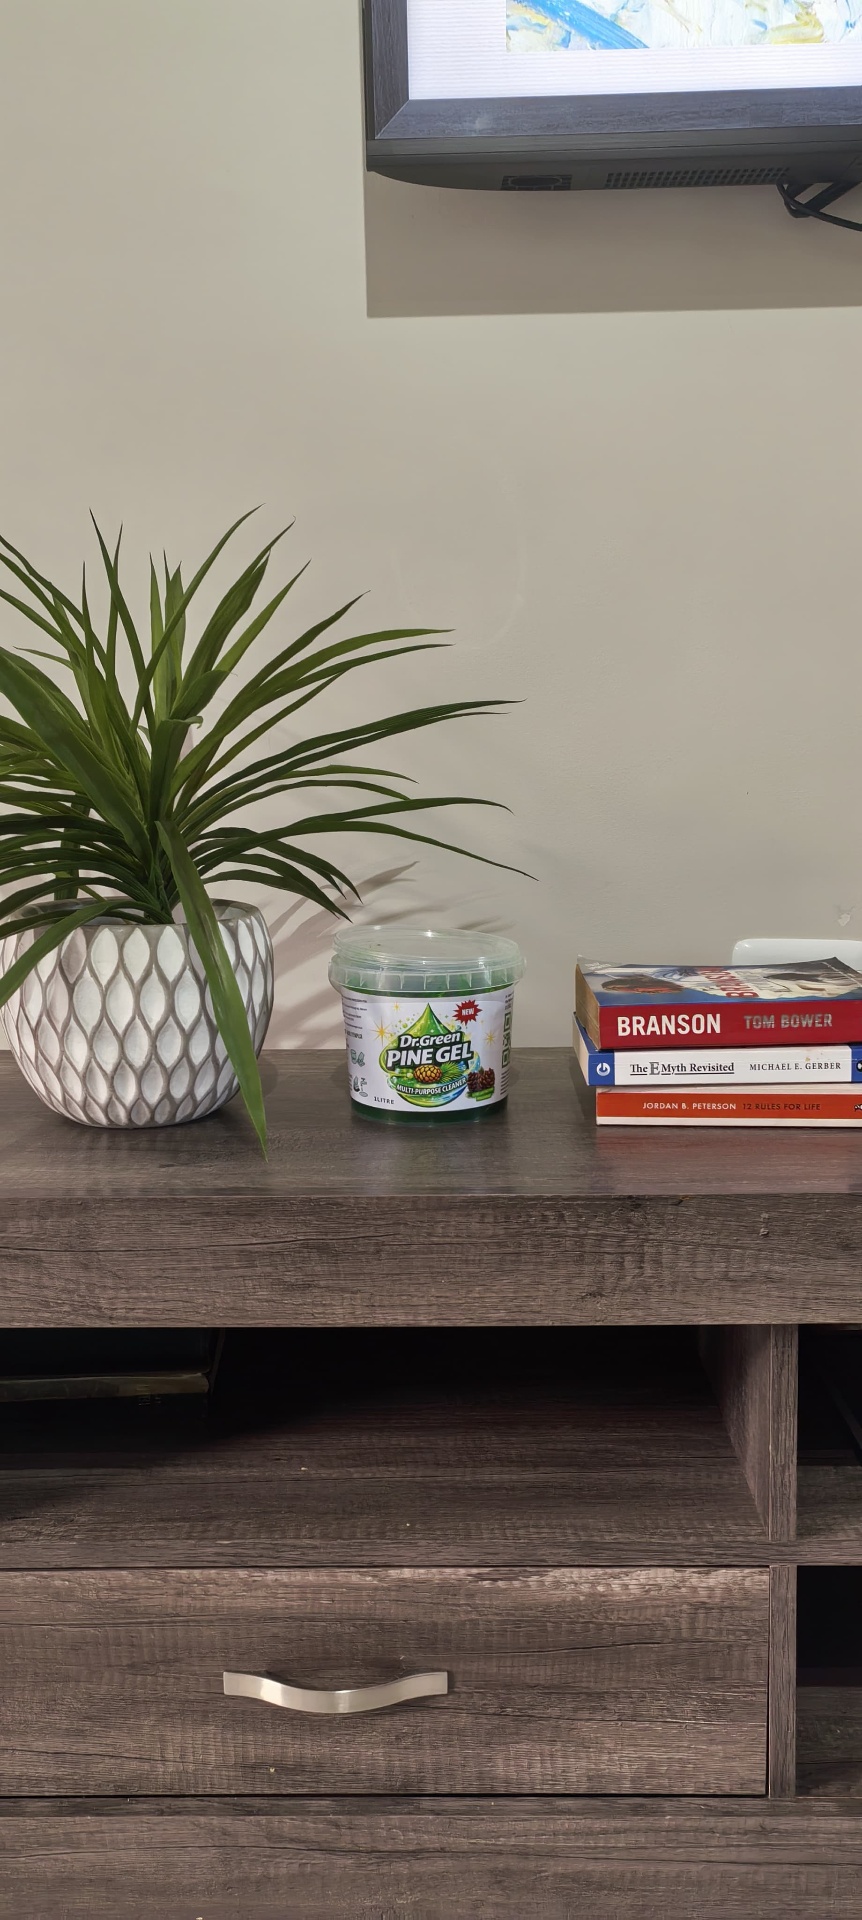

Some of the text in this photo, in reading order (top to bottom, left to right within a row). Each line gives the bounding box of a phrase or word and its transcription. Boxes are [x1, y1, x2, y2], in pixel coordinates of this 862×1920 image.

[461, 1008, 475, 1016] NEW
[617, 1013, 833, 1036] BRANSON TOM BOWER
[400, 1032, 460, 1048] Dr.Green
[387, 1042, 472, 1067] PINE GEL
[630, 1061, 735, 1076] The E Myth Revisited
[749, 1062, 842, 1071] MICHAEL E. GERBER
[396, 1077, 467, 1095] MULTI-PURPOSE CLEANER
[642, 1102, 679, 1110] JORDAN
[681, 1102, 690, 1110] B.
[692, 1103, 737, 1111] PETERSON
